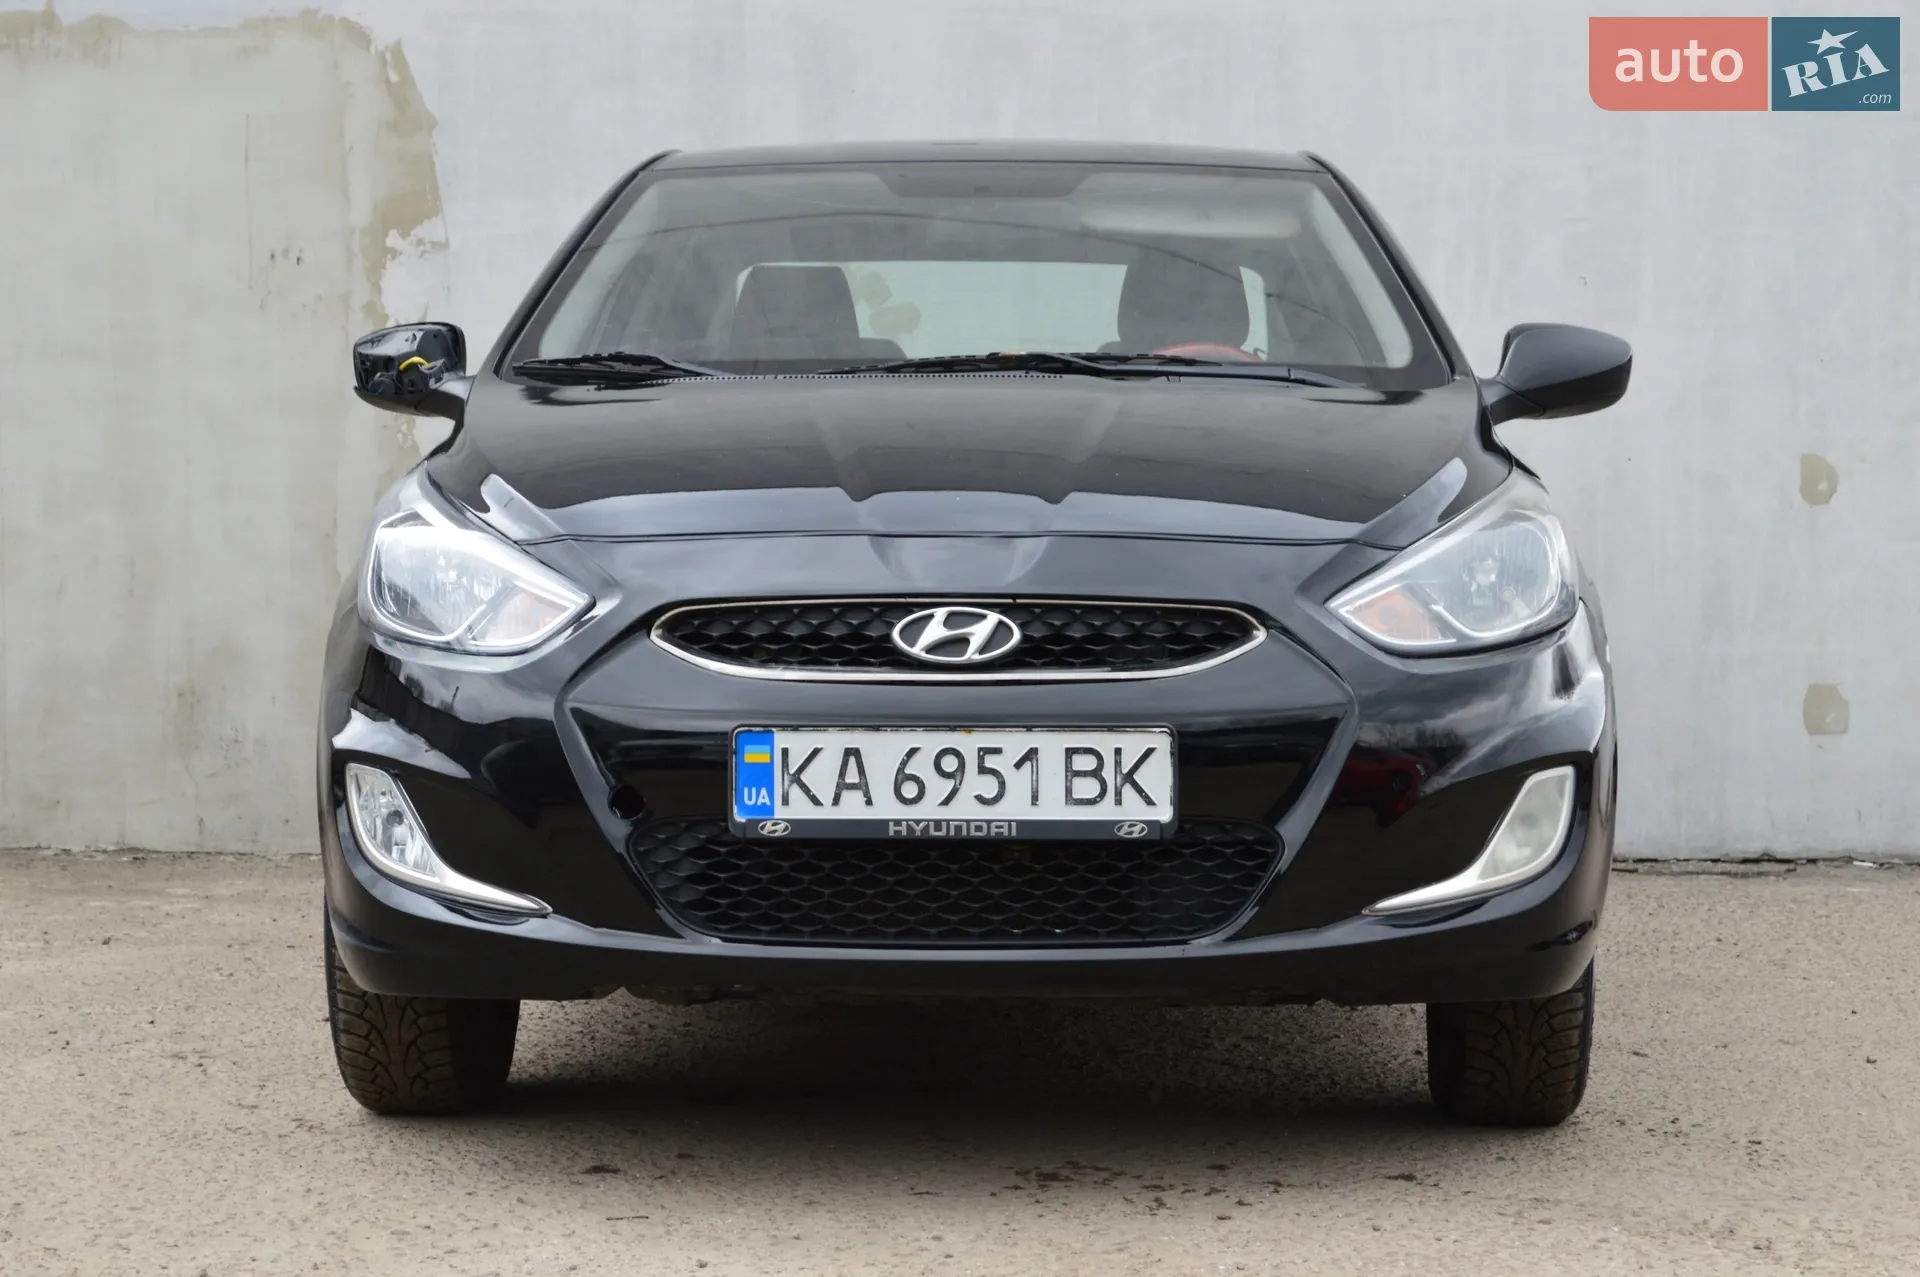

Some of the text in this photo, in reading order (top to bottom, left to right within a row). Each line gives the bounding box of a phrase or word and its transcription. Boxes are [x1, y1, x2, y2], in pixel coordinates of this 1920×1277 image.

[781, 746, 1158, 806] KA 6951 BK
[743, 787, 771, 806] UA
[888, 821, 1017, 837] HYUNDAI
